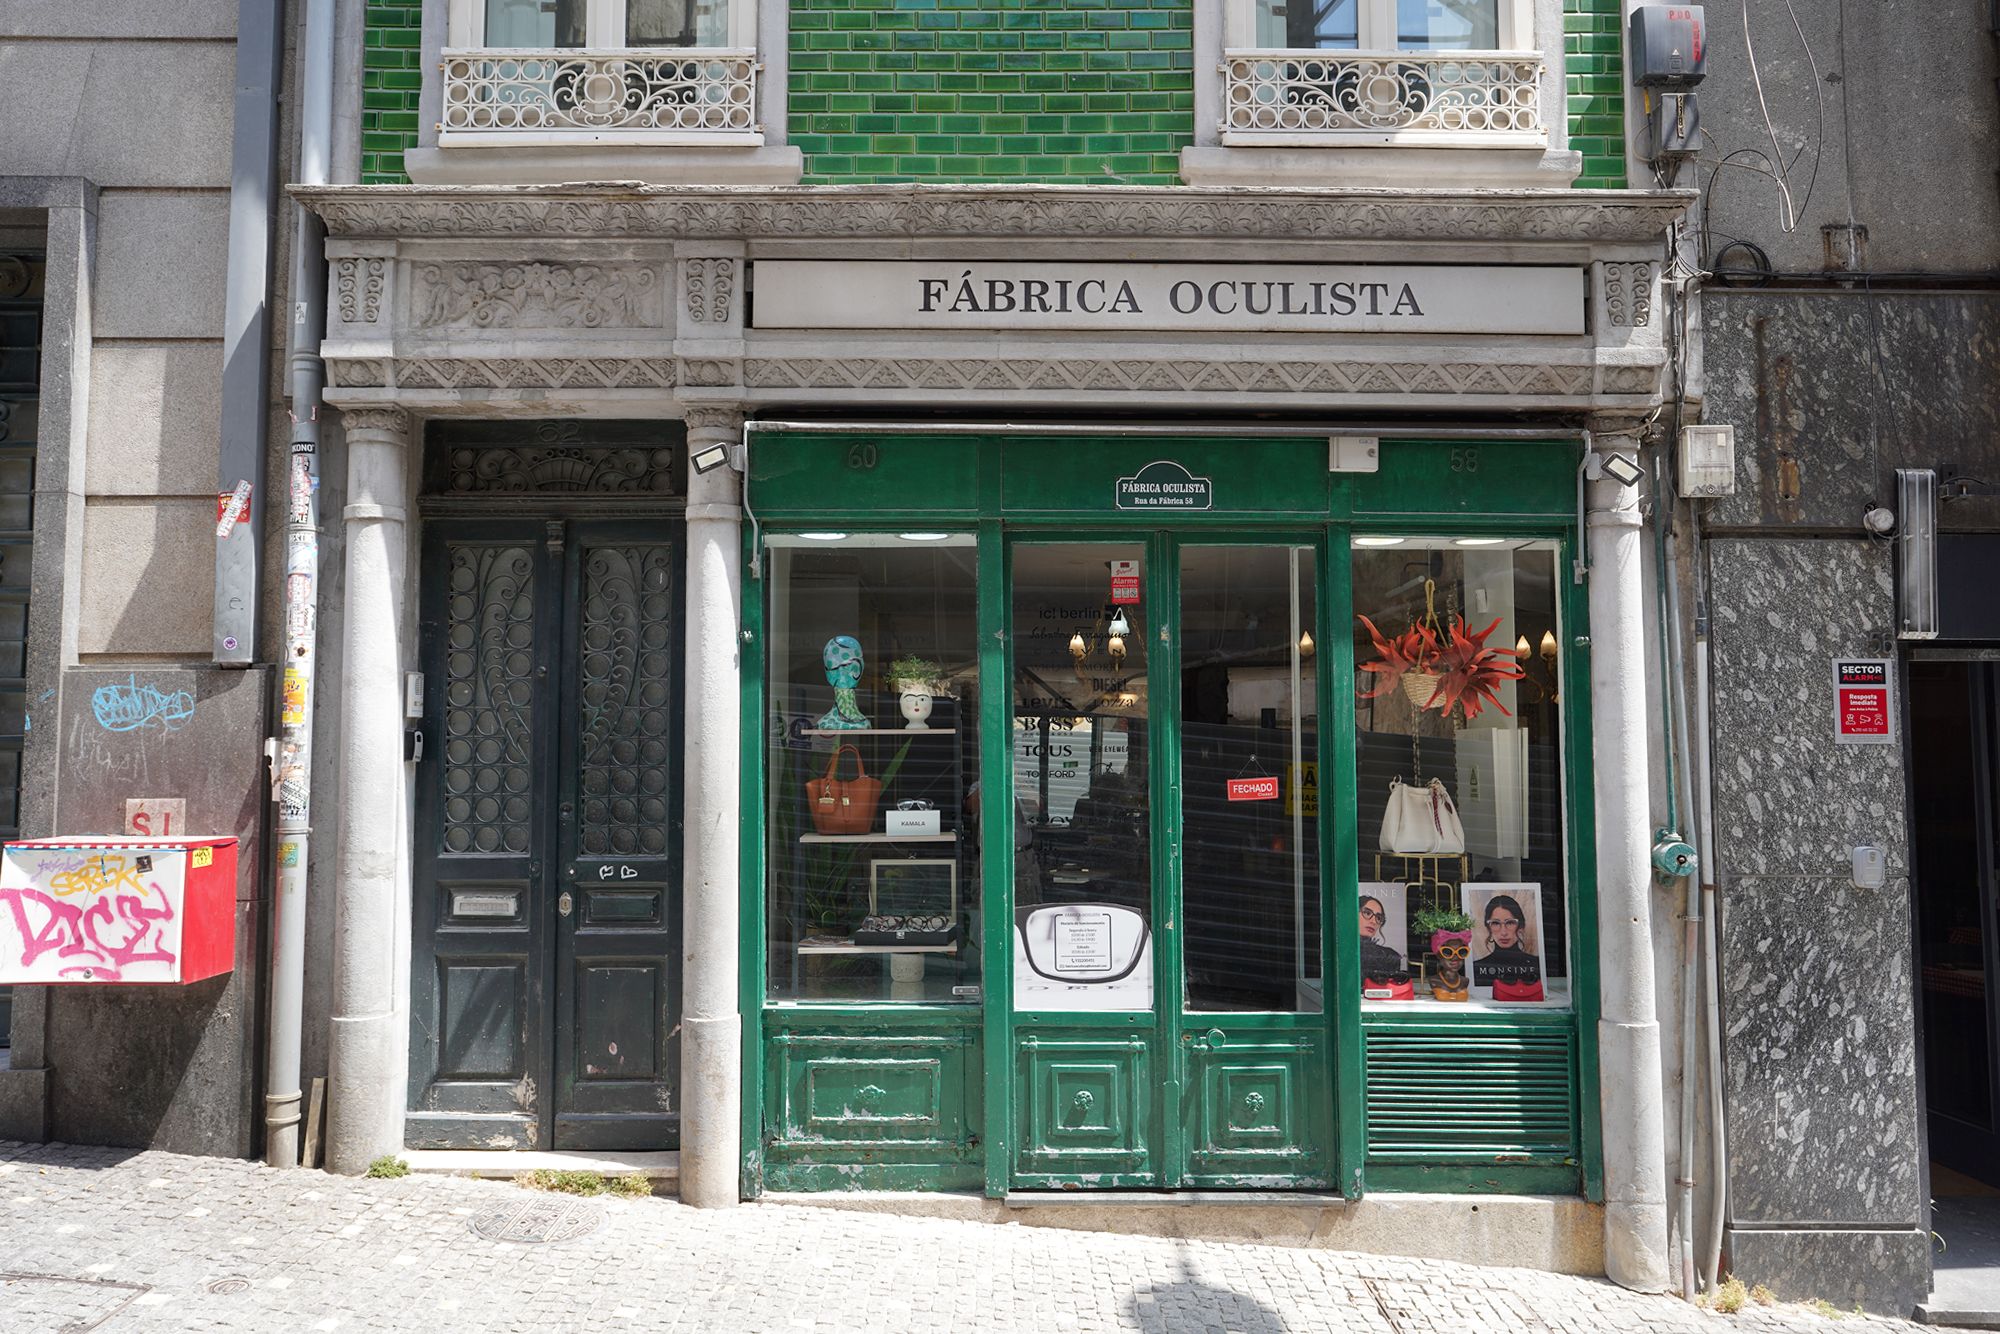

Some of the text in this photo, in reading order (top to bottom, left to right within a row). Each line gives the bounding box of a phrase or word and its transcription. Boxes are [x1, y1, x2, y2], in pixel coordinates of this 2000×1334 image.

[918, 269, 1425, 317] FÁBRICA OCULISTA
[536, 421, 582, 441] 62
[848, 443, 877, 469] 60
[1450, 448, 1478, 472] 58
[1122, 481, 1206, 493] FÁBRICA OCULISTA
[1134, 497, 1148, 505] Rua
[1149, 497, 1157, 505] da
[1159, 497, 1184, 505] Fábrica
[1060, 607, 1101, 619] berlin
[1841, 665, 1882, 674] SECTOR
[1092, 678, 1129, 692] DIESEL
[1022, 745, 1073, 757] TOUS
[1048, 770, 1076, 778] FORD
[1233, 783, 1273, 793] FECHADO
